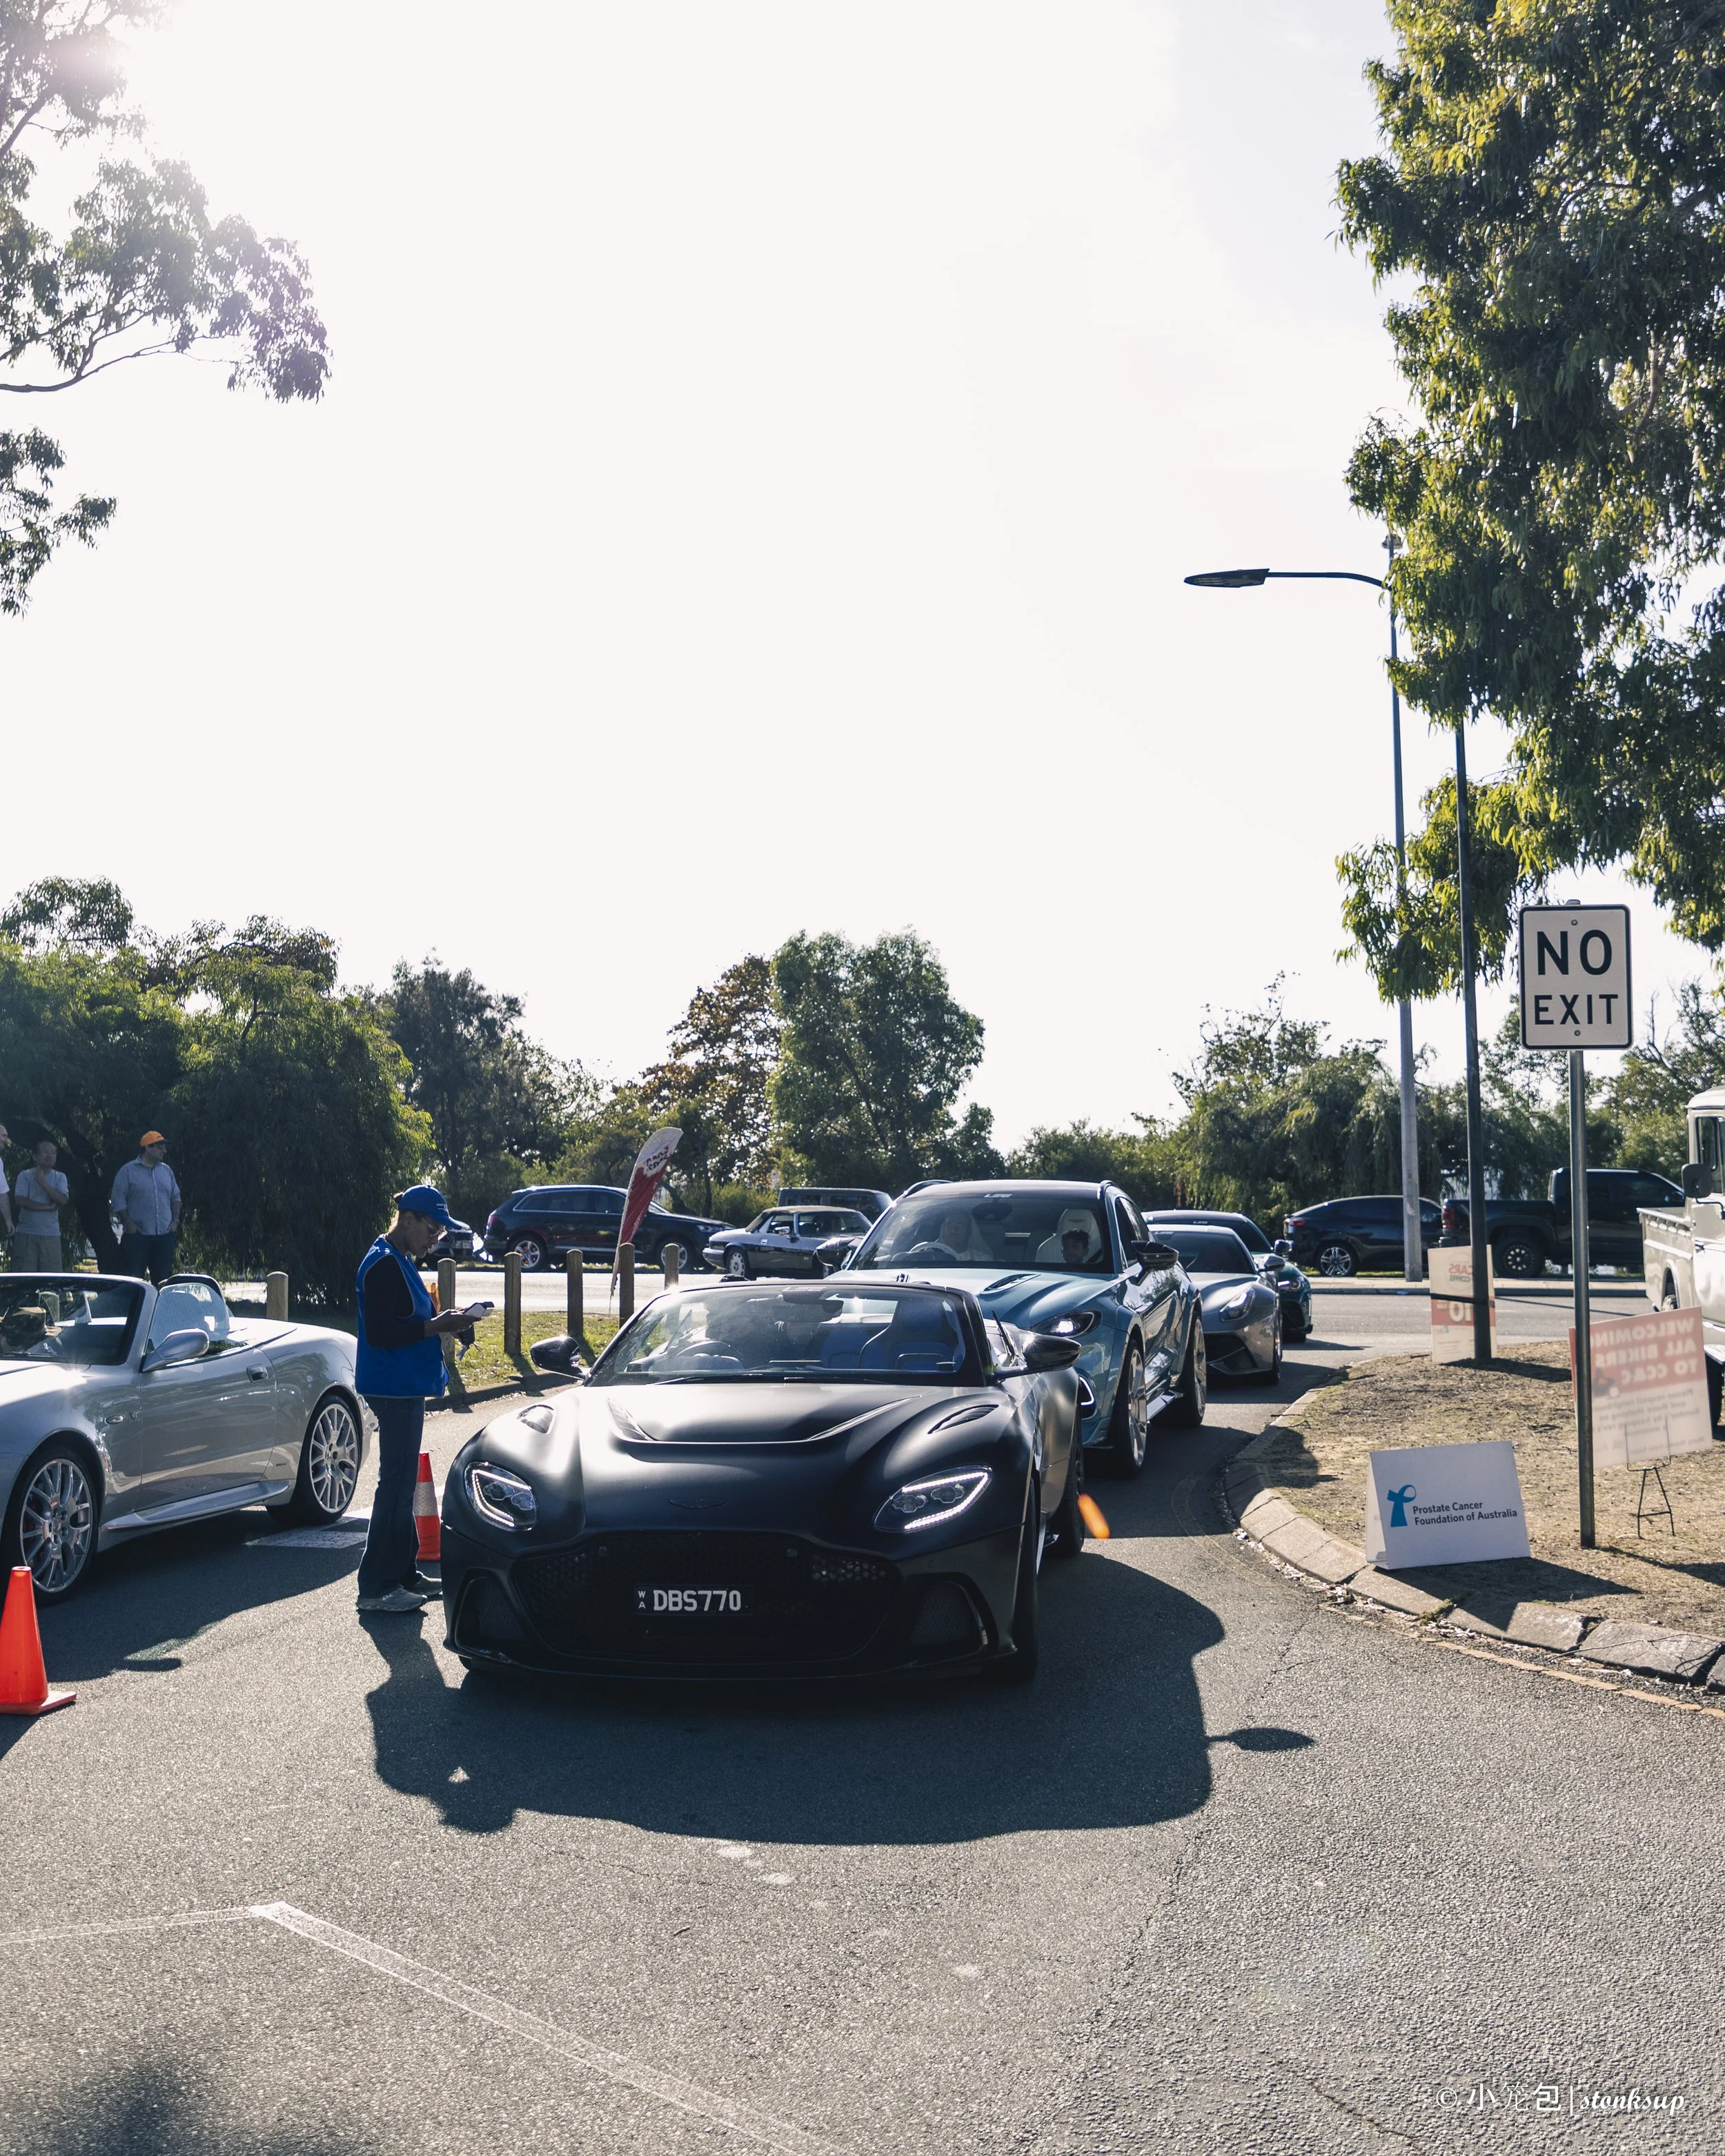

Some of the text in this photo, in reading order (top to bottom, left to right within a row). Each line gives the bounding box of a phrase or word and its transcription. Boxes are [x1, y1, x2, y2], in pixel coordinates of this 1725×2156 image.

[1537, 929, 1613, 976] NO
[1534, 994, 1618, 1025] EXIT
[1412, 1502, 1483, 1514] Prostate Cancer
[1414, 1508, 1518, 1525] Foundation of Australia
[653, 1590, 741, 1612] DBS770
